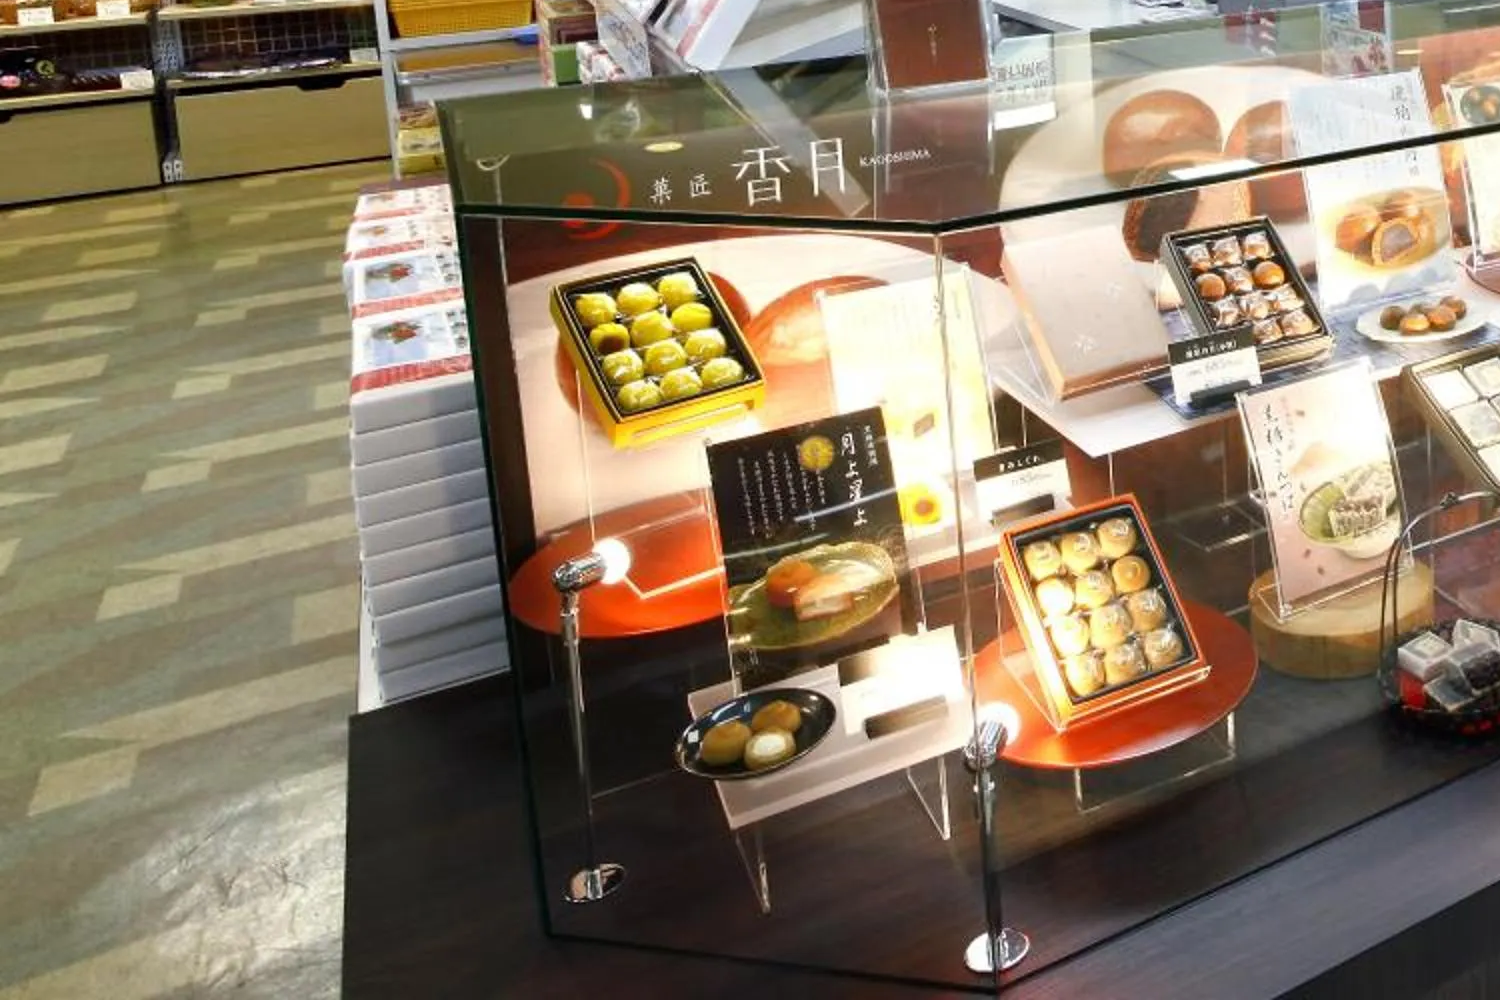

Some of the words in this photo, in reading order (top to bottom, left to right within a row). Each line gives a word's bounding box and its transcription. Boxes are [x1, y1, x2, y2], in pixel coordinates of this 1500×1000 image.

[650, 173, 712, 206] 菓匠
[731, 137, 846, 207] 香月
[859, 149, 932, 169] KAGOSHIMA
